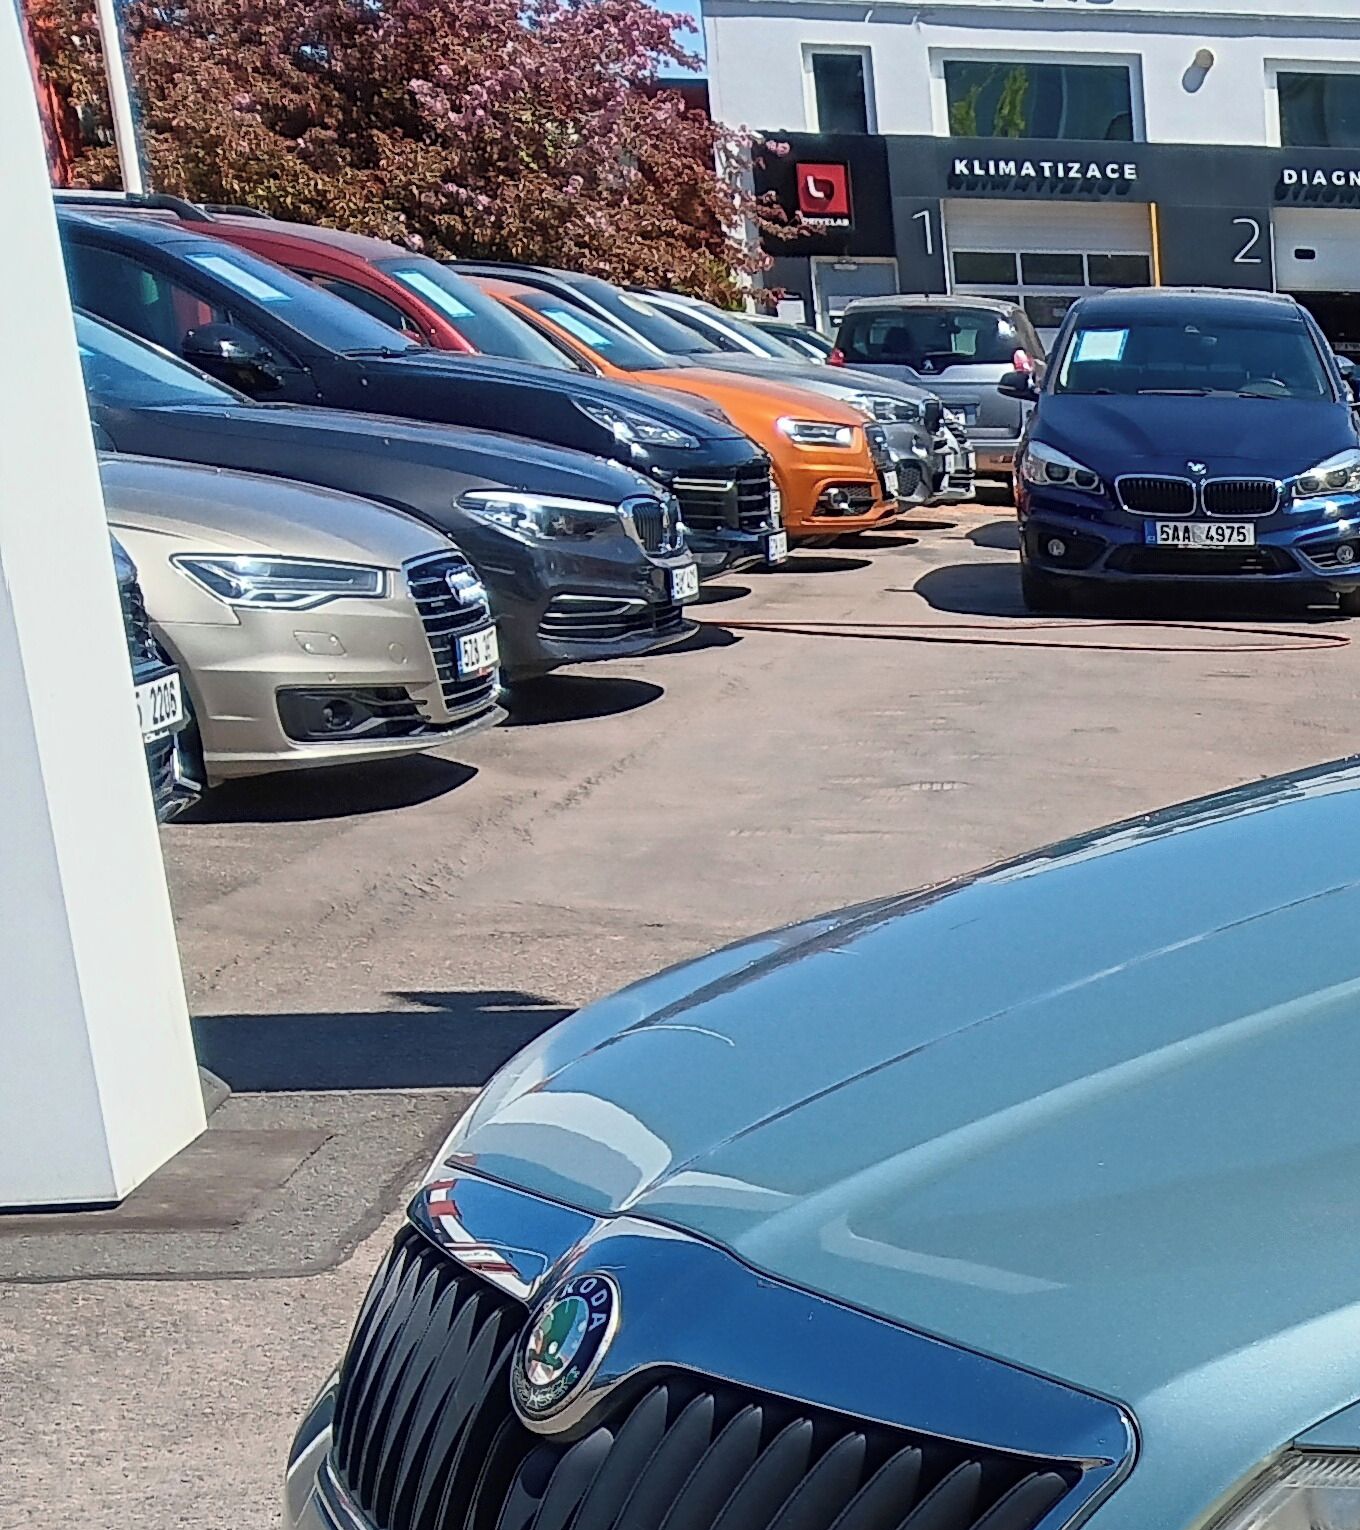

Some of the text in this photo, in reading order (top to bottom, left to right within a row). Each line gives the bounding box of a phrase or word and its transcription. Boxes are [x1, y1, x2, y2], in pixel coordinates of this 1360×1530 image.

[954, 159, 1137, 180] KLIMATIZACE
[911, 210, 933, 255] 1
[1233, 218, 1262, 263] 2
[1160, 524, 1247, 543] 5AA 4975
